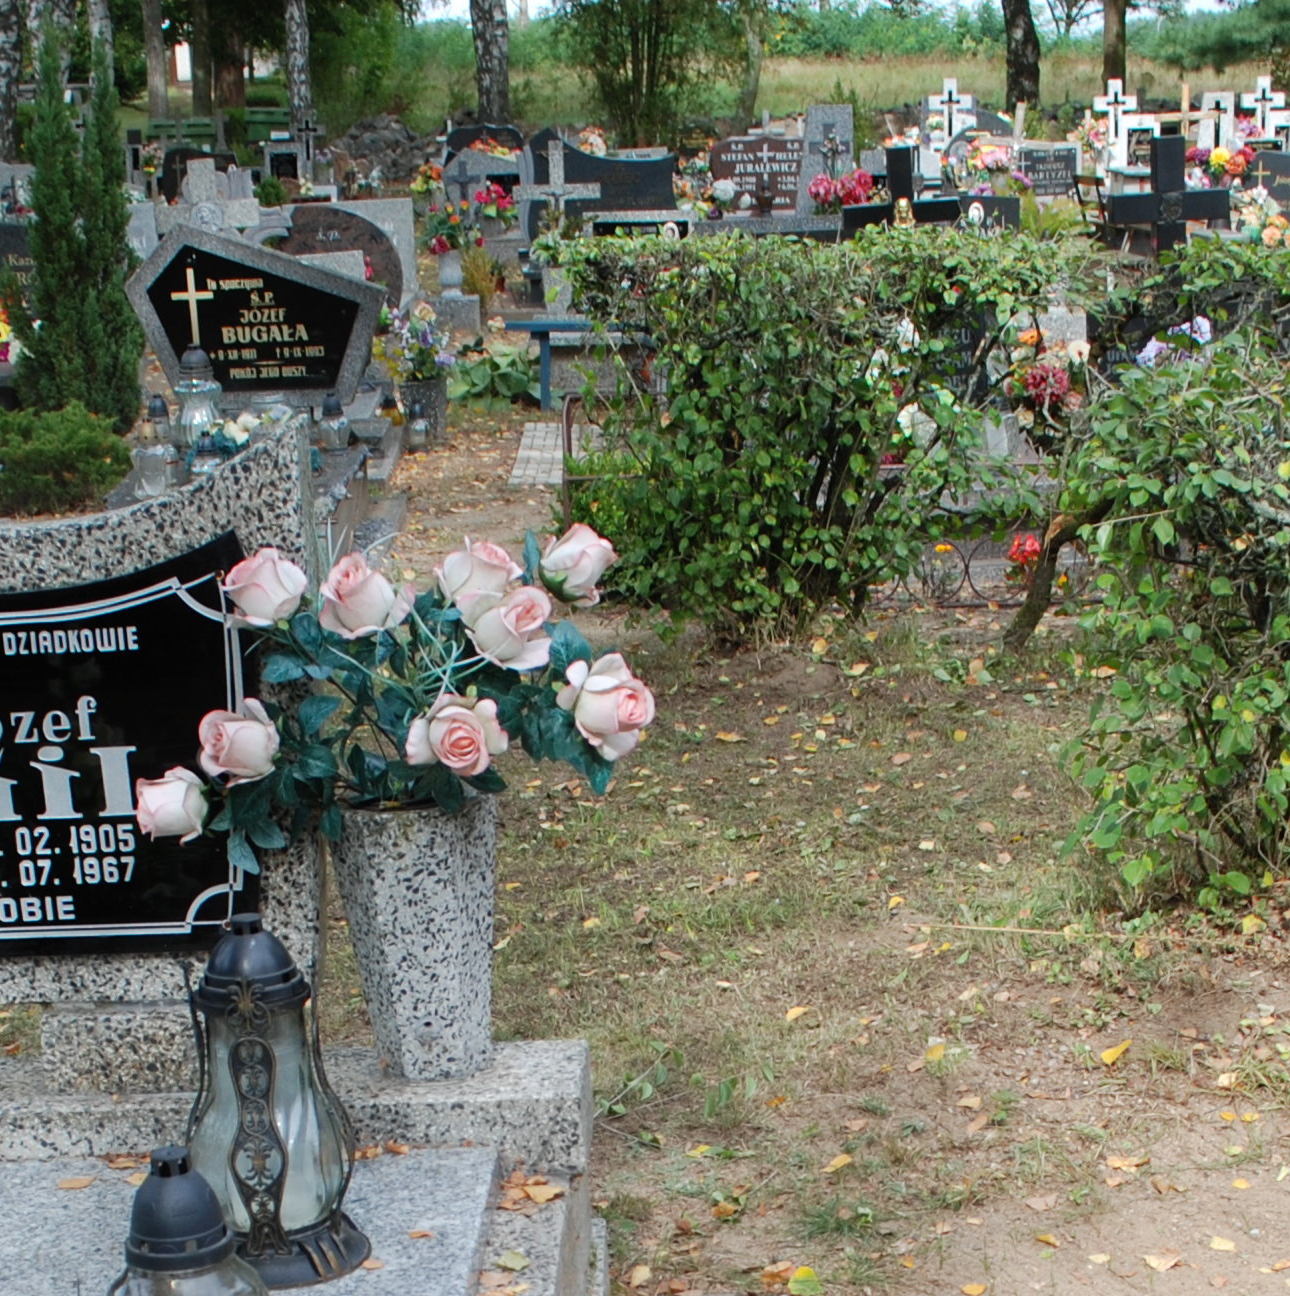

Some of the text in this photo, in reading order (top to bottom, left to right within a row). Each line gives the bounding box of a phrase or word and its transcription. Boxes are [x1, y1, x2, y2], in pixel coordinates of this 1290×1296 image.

[720, 152, 755, 162] STEFAN
[734, 162, 798, 174] JURALEWICZ
[239, 306, 287, 324] JÓZEF
[221, 323, 310, 345] BUGAŁA
[3, 625, 140, 656] DZIADKOWIE
[68, 823, 136, 854] 1905
[71, 856, 136, 886] 1967
